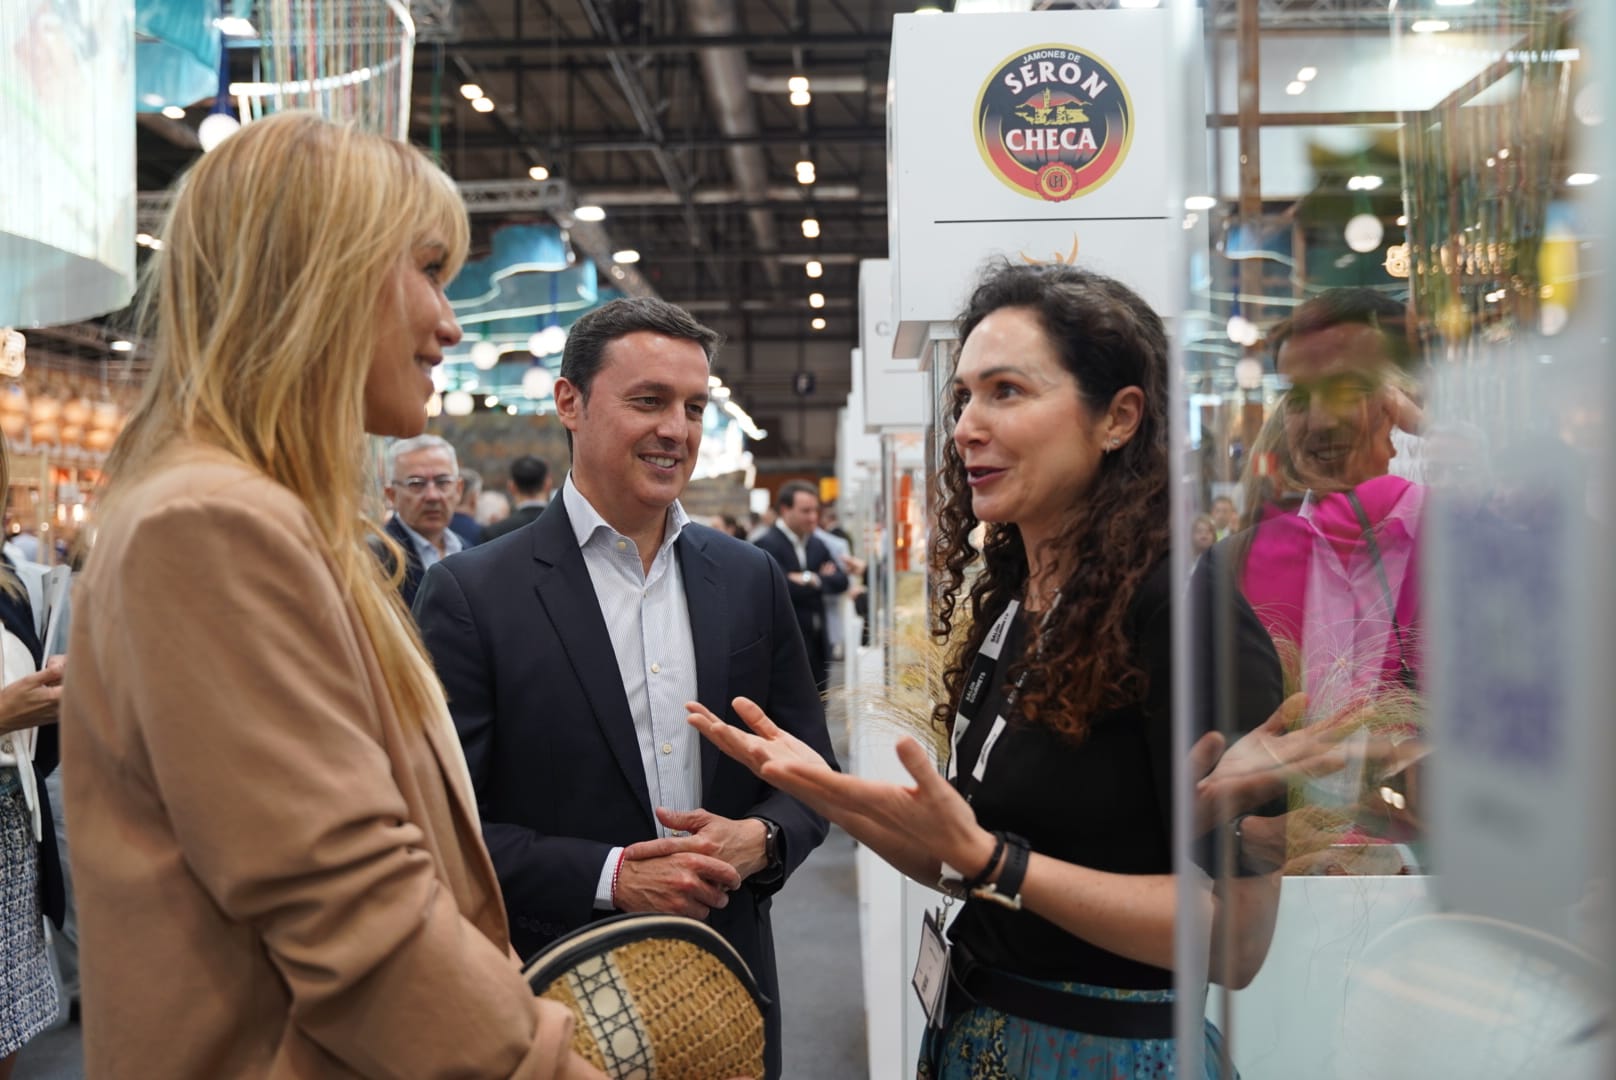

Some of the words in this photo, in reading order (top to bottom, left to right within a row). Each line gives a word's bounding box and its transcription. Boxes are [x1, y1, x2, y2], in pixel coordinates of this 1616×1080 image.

[1023, 50, 1066, 64] JAMONES
[1067, 54, 1081, 63] DE
[1004, 61, 1108, 99] SERON
[1005, 127, 1098, 151] CHECA
